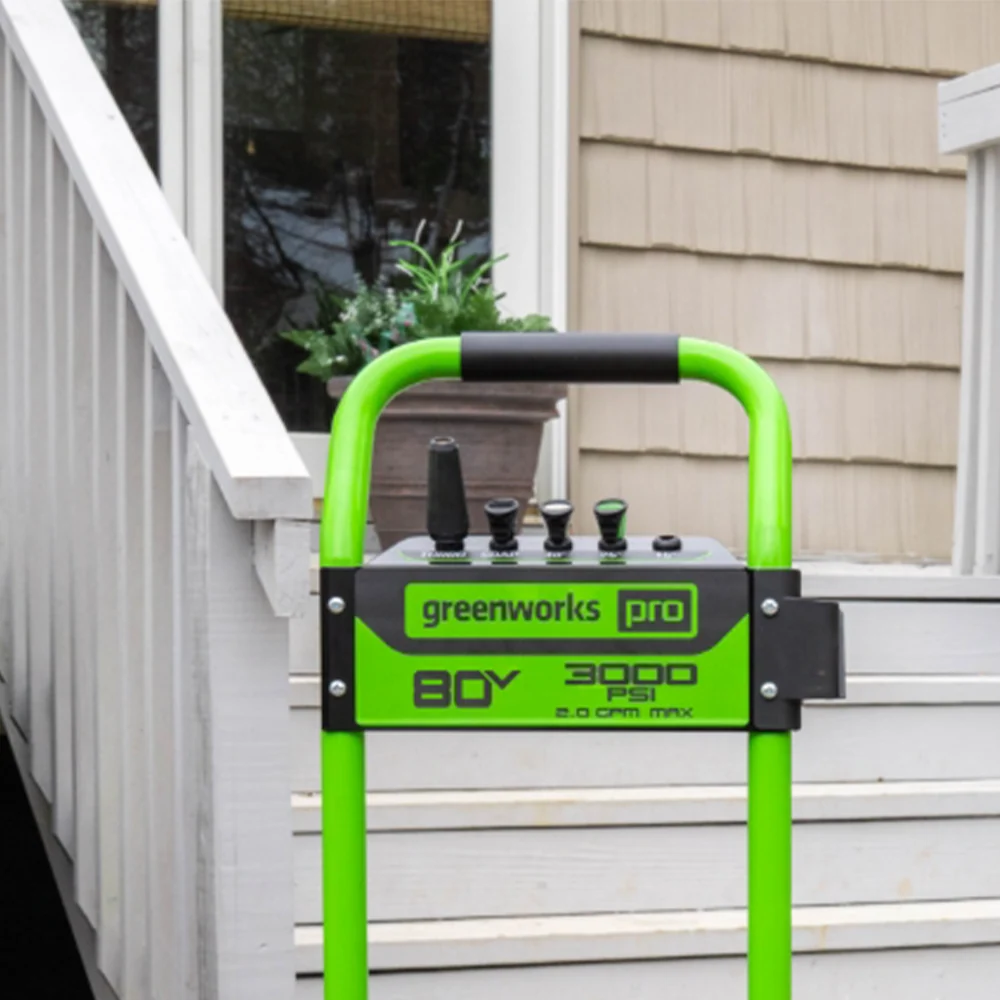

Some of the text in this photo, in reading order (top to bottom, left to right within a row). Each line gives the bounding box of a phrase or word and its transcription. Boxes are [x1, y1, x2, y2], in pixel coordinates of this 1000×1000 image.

[422, 592, 685, 629] greenworks pro
[564, 663, 698, 685] 3000
[413, 669, 521, 708] 80V
[606, 687, 656, 702] PSI
[555, 707, 590, 718] 2.0
[649, 707, 694, 718] MAX
